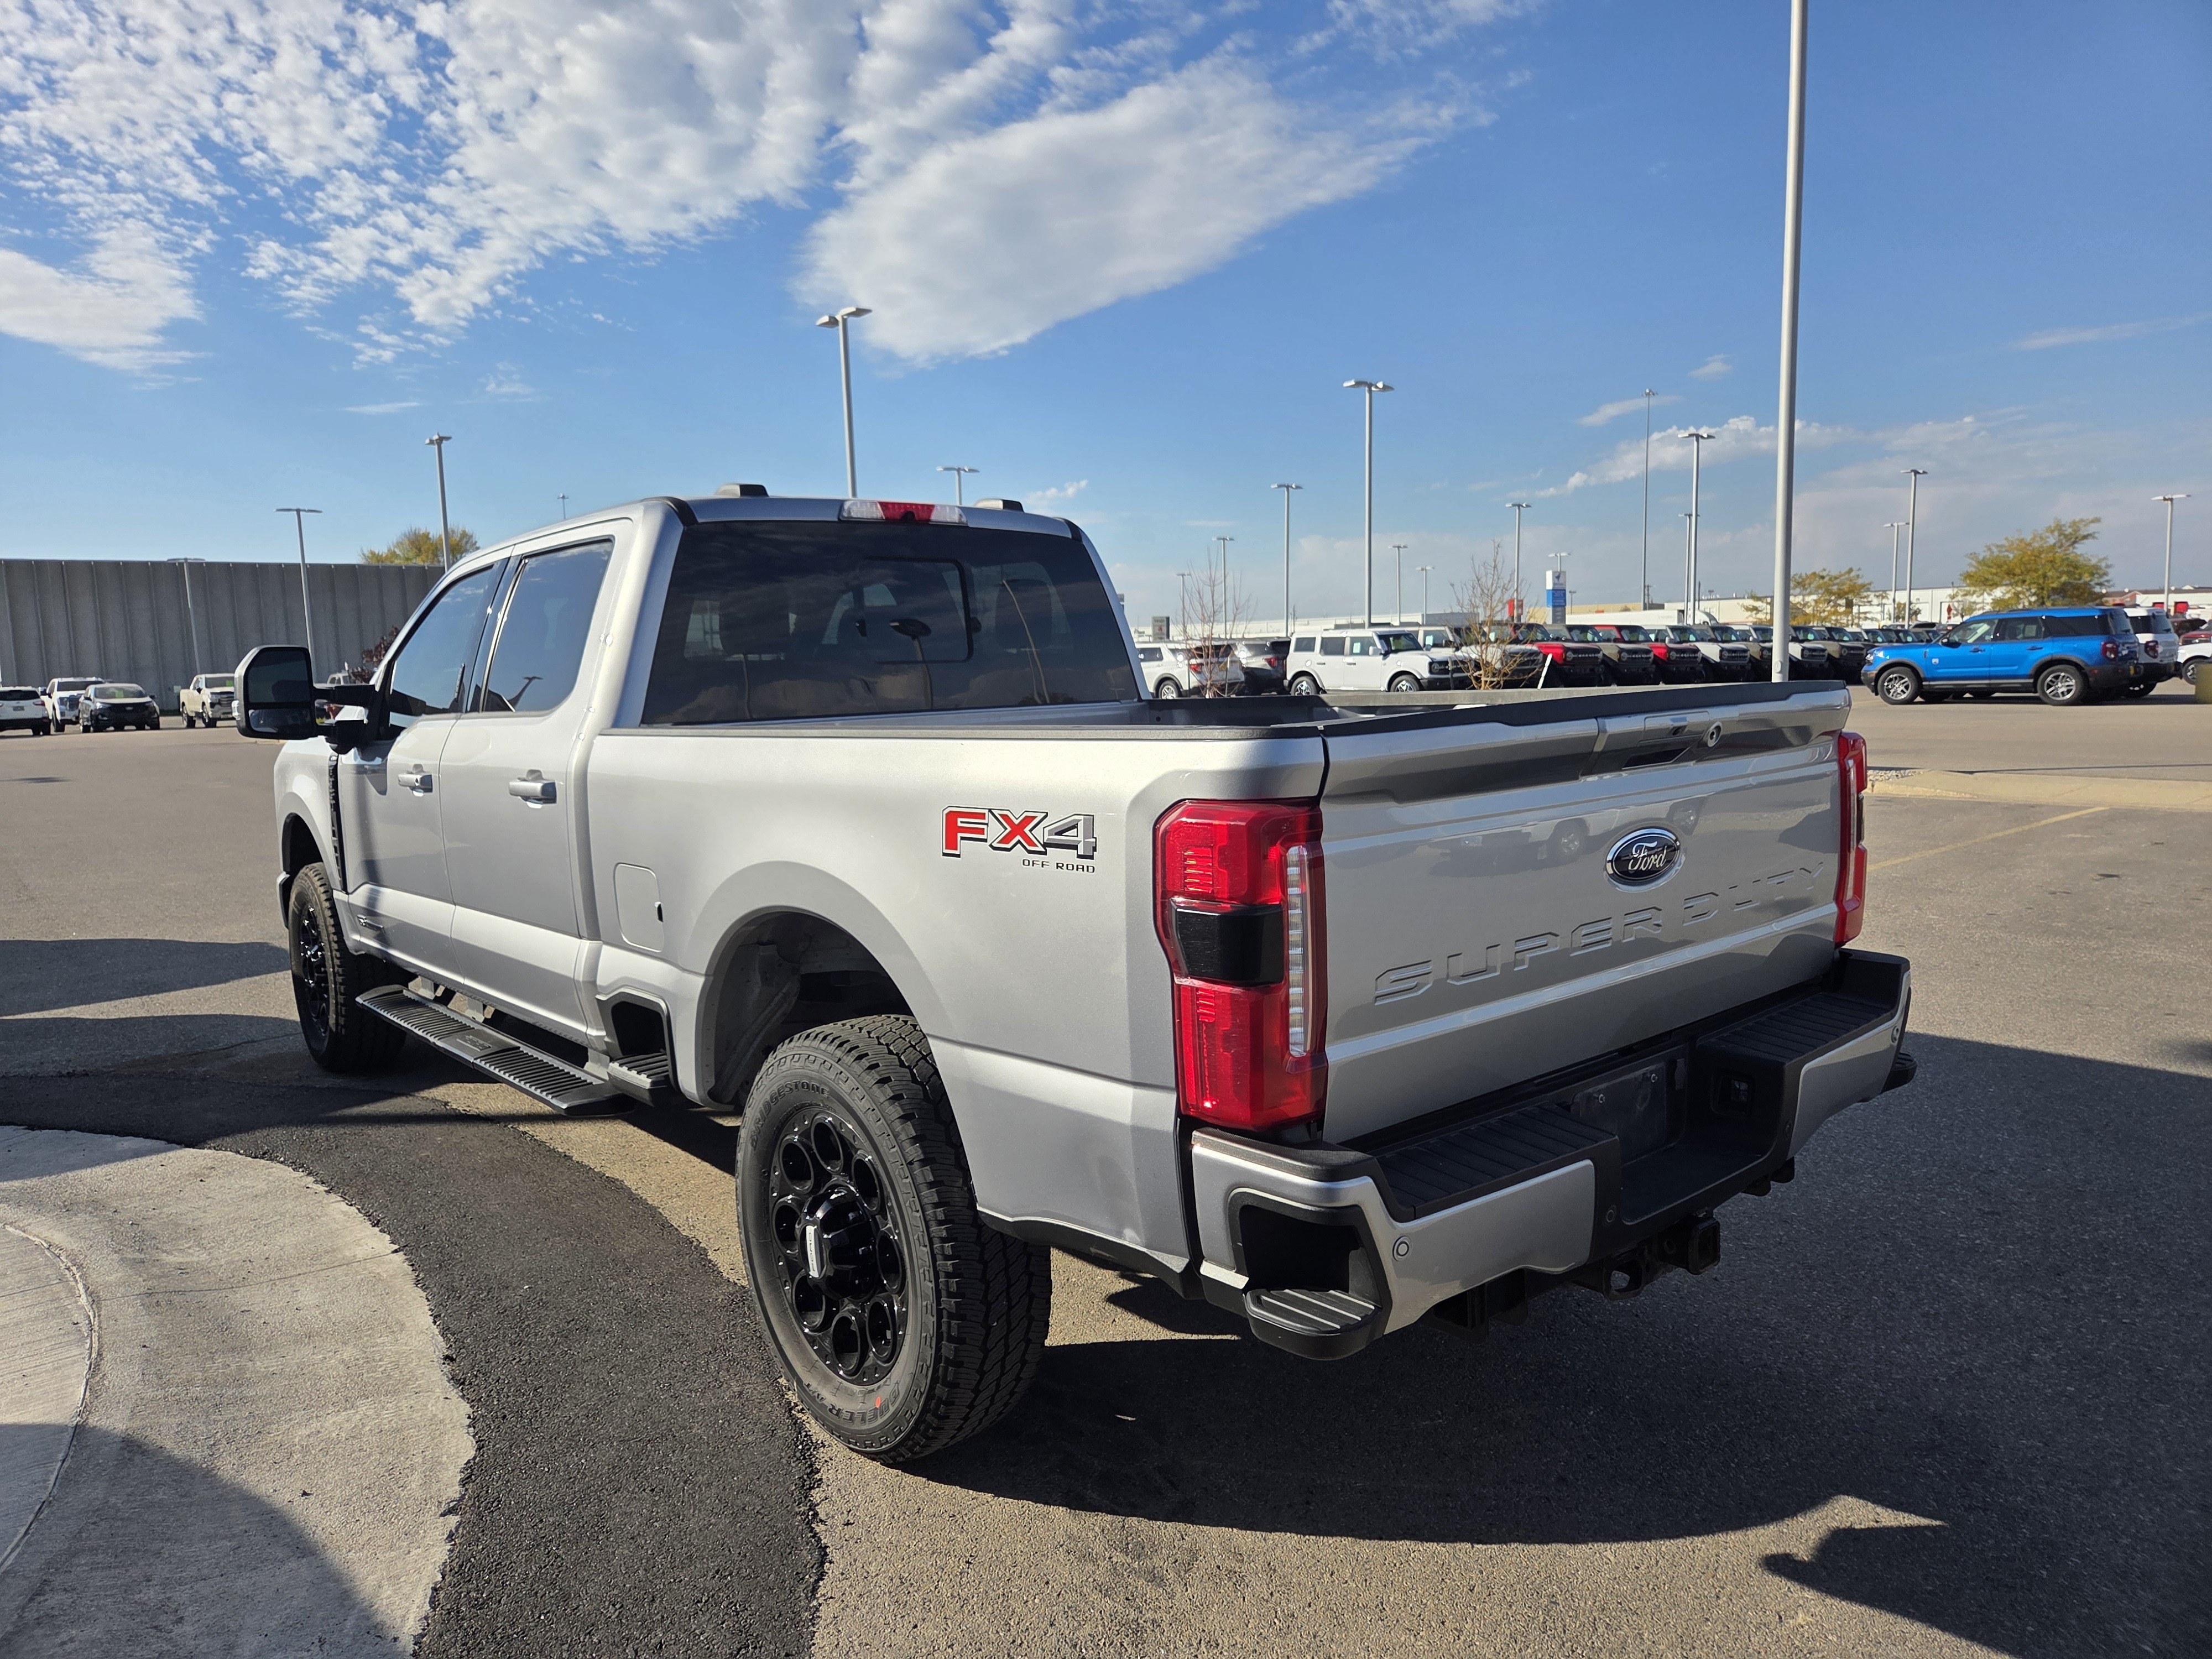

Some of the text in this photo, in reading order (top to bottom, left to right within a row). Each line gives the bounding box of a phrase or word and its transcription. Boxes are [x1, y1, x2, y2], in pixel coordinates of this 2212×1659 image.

[942, 806, 1097, 860] FX4
[1628, 841, 1667, 873] Ford
[1022, 858, 1095, 873] OFF ROAD
[1374, 861, 1824, 1005] SUPER DUTY
[750, 1079, 830, 1151] BRIDGESTONE
